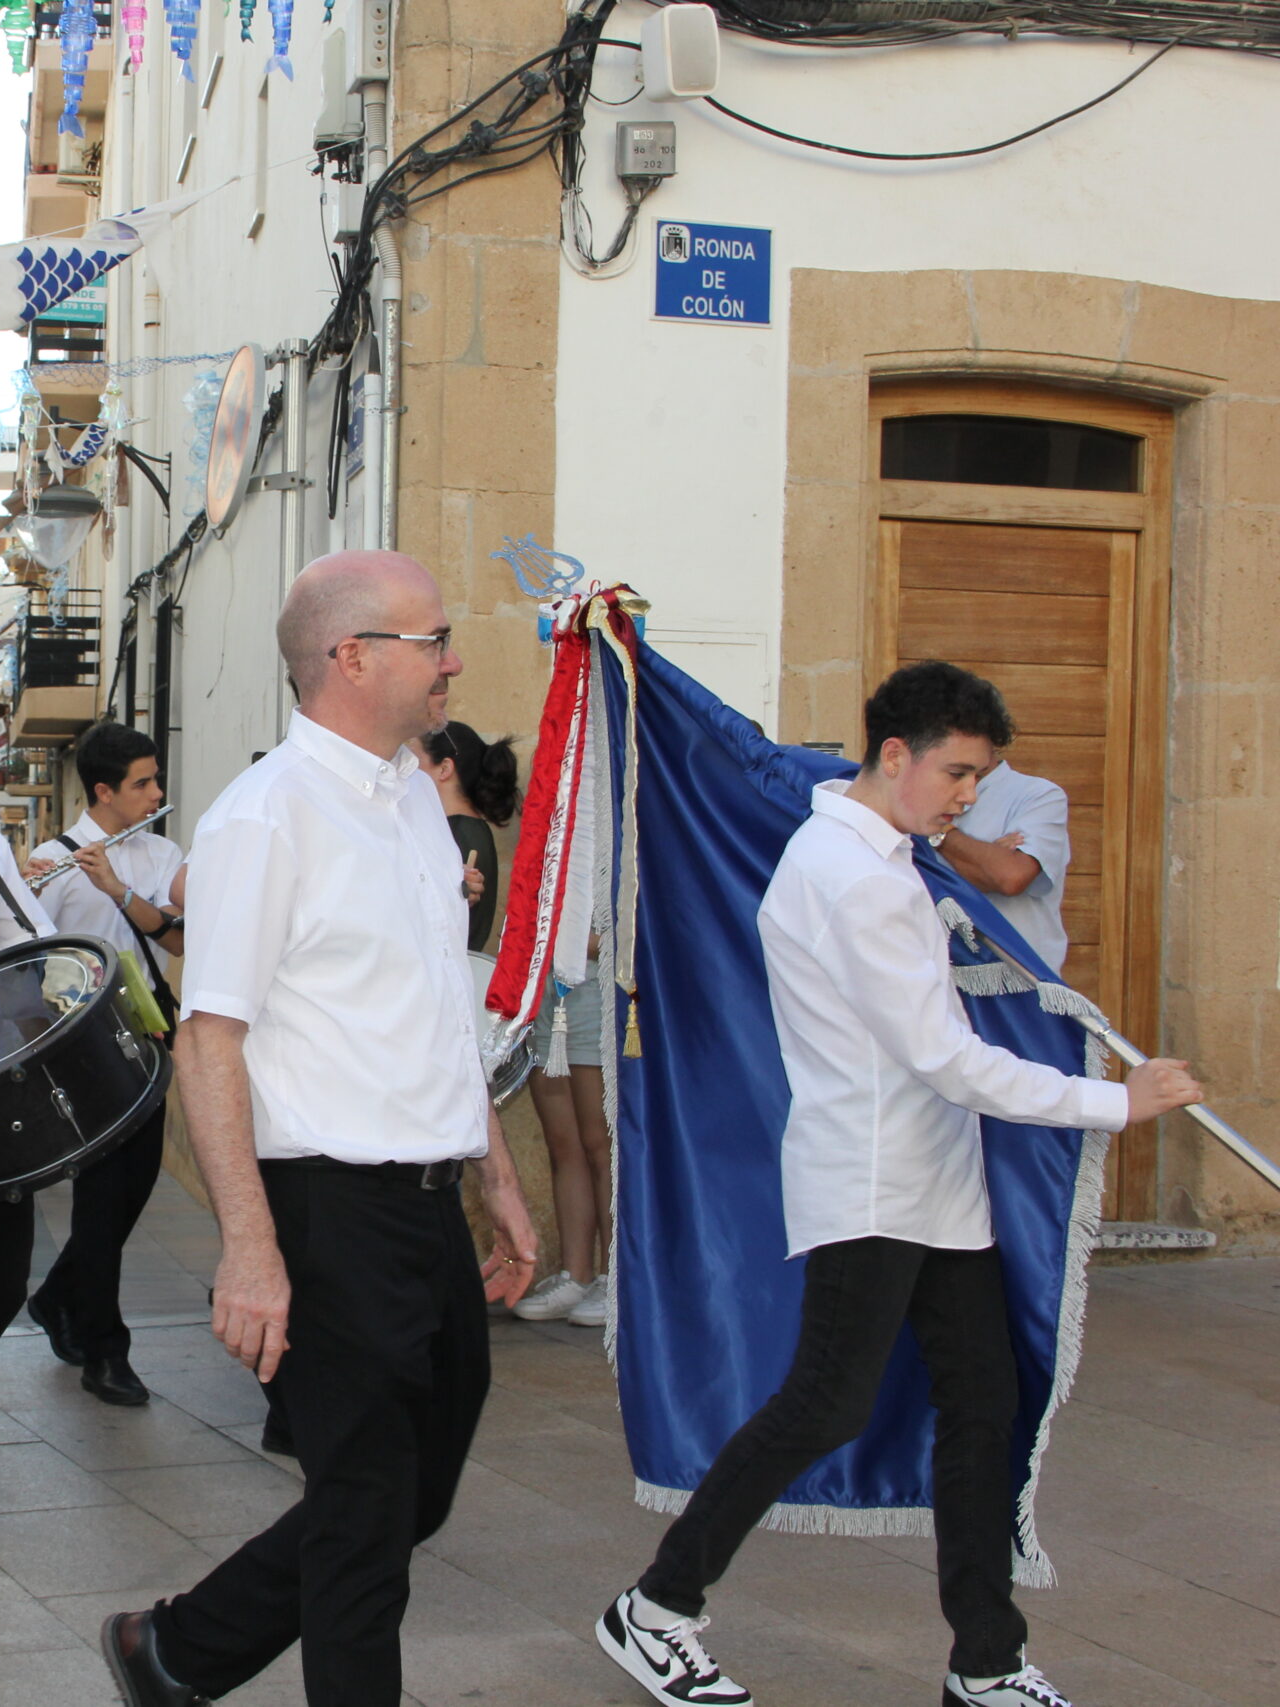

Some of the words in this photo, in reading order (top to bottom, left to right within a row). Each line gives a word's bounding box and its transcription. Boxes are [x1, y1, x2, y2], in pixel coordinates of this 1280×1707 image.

[643, 160, 663, 169] 202
[694, 237, 756, 261] RONDA
[702, 269, 726, 290] DE
[682, 294, 745, 319] COLÓN
[540, 915, 551, 933] de
